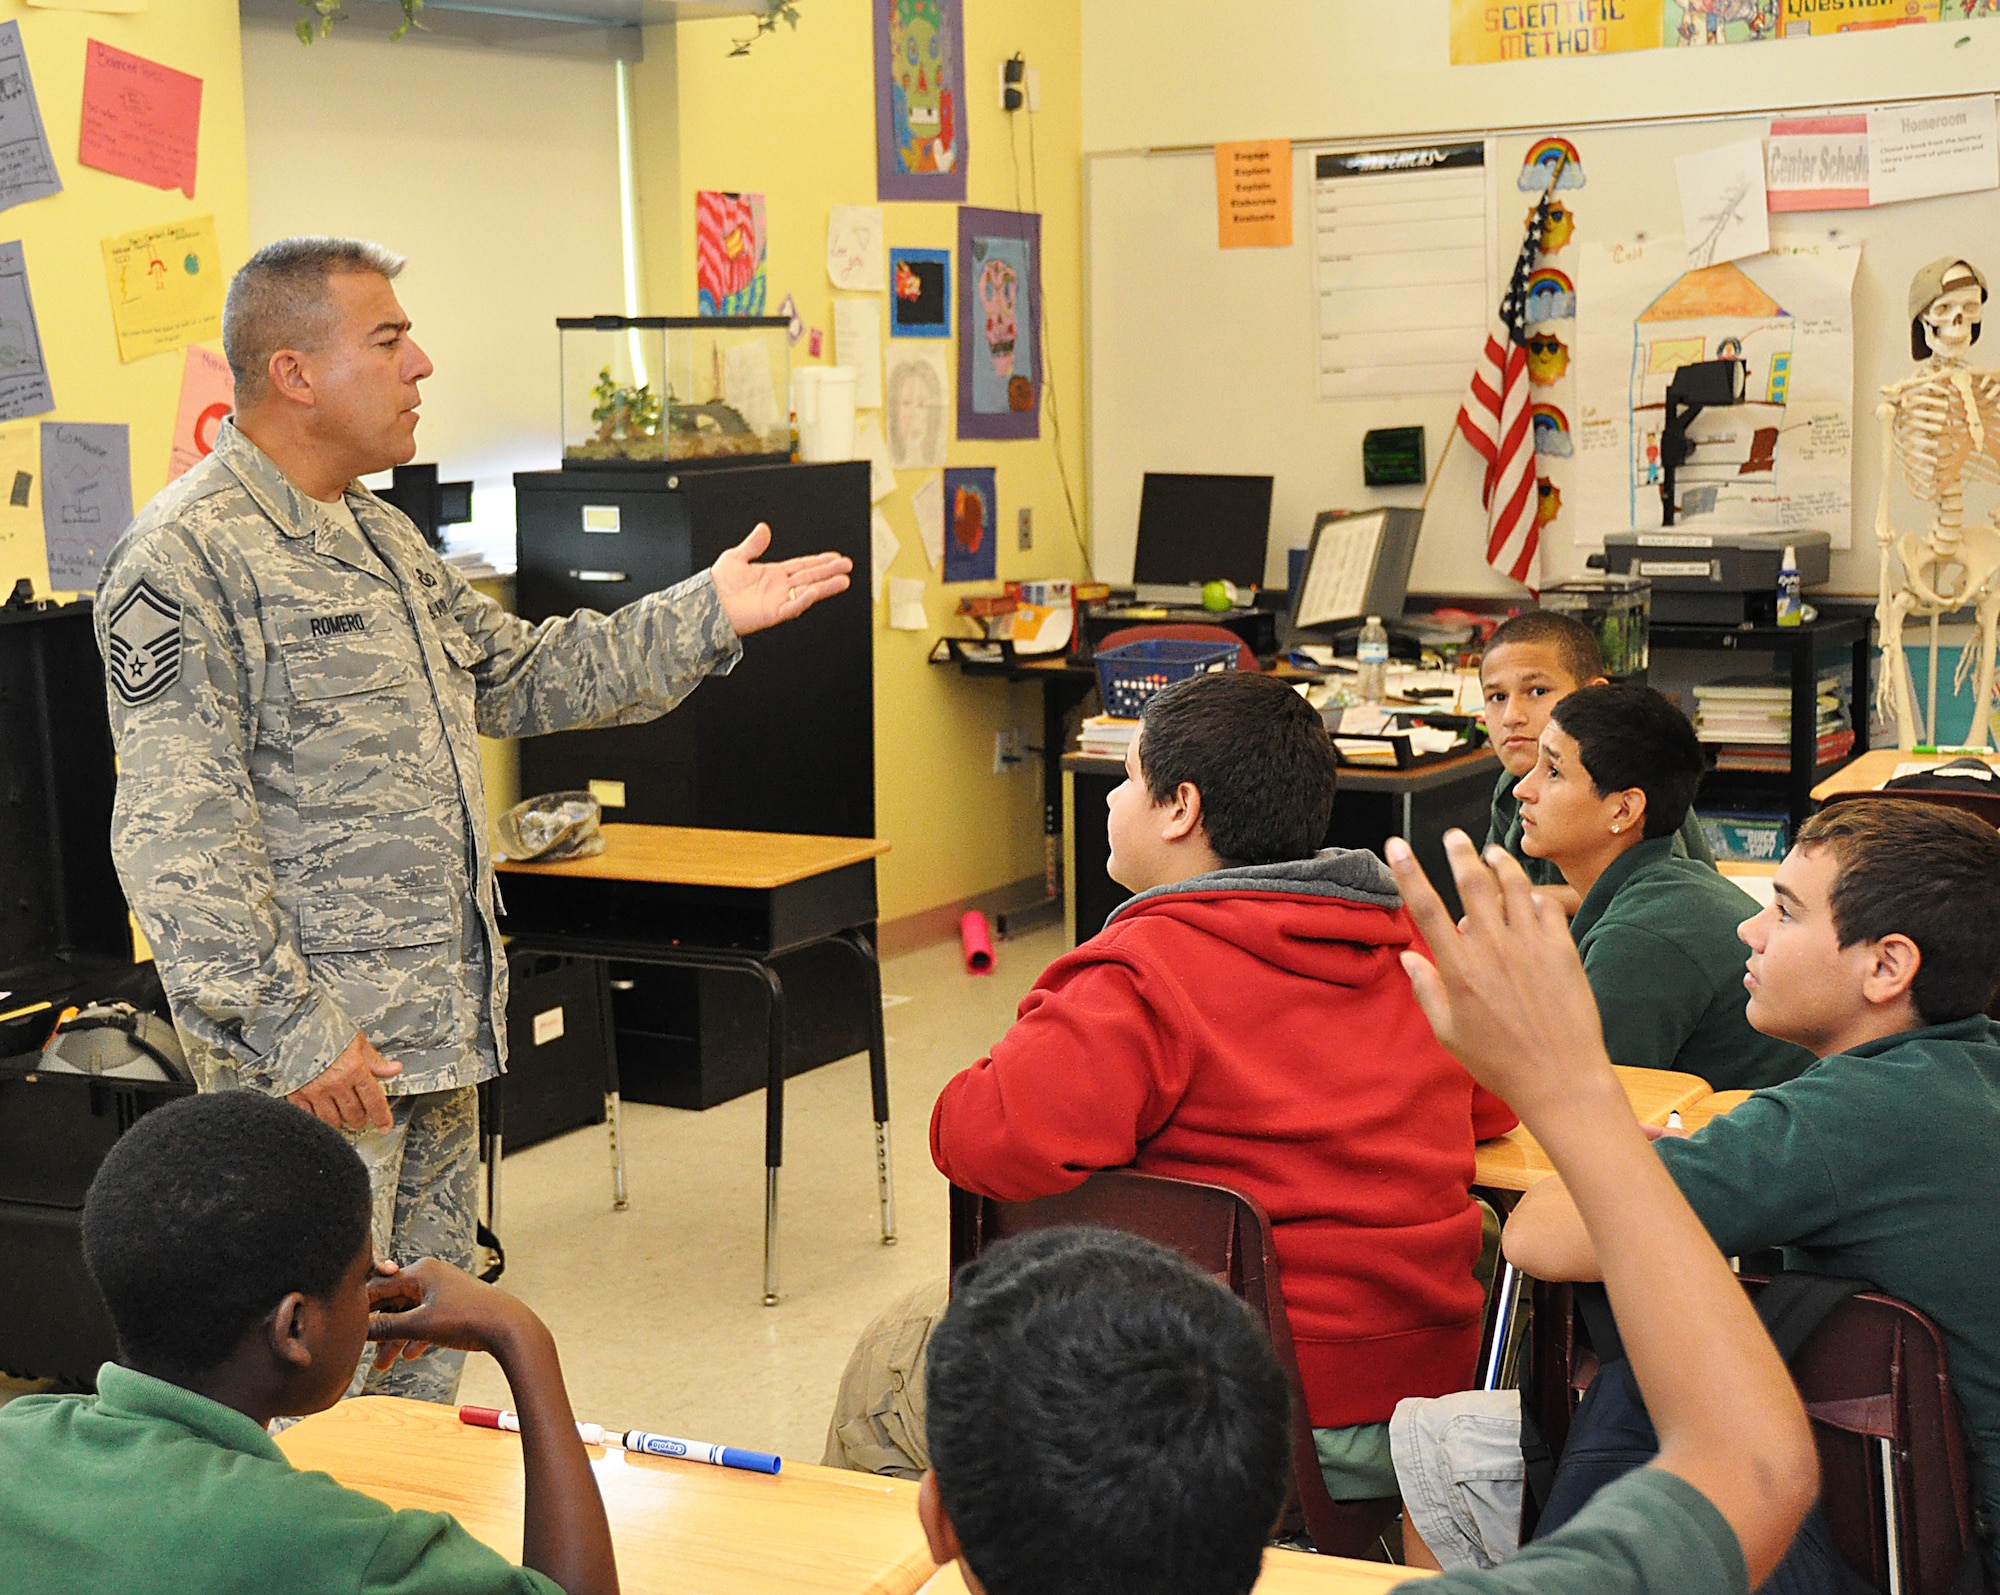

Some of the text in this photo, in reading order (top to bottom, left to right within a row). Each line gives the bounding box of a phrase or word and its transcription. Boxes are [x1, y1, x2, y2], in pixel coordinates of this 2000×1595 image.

[1485, 0, 1625, 31] SCIENTIFIC
[1500, 27, 1608, 60] METHOD
[1901, 113, 1967, 134] Homeroom
[1770, 146, 1818, 184] Center
[310, 613, 365, 638] ROMERO
[652, 1440, 684, 1454] Crayola
